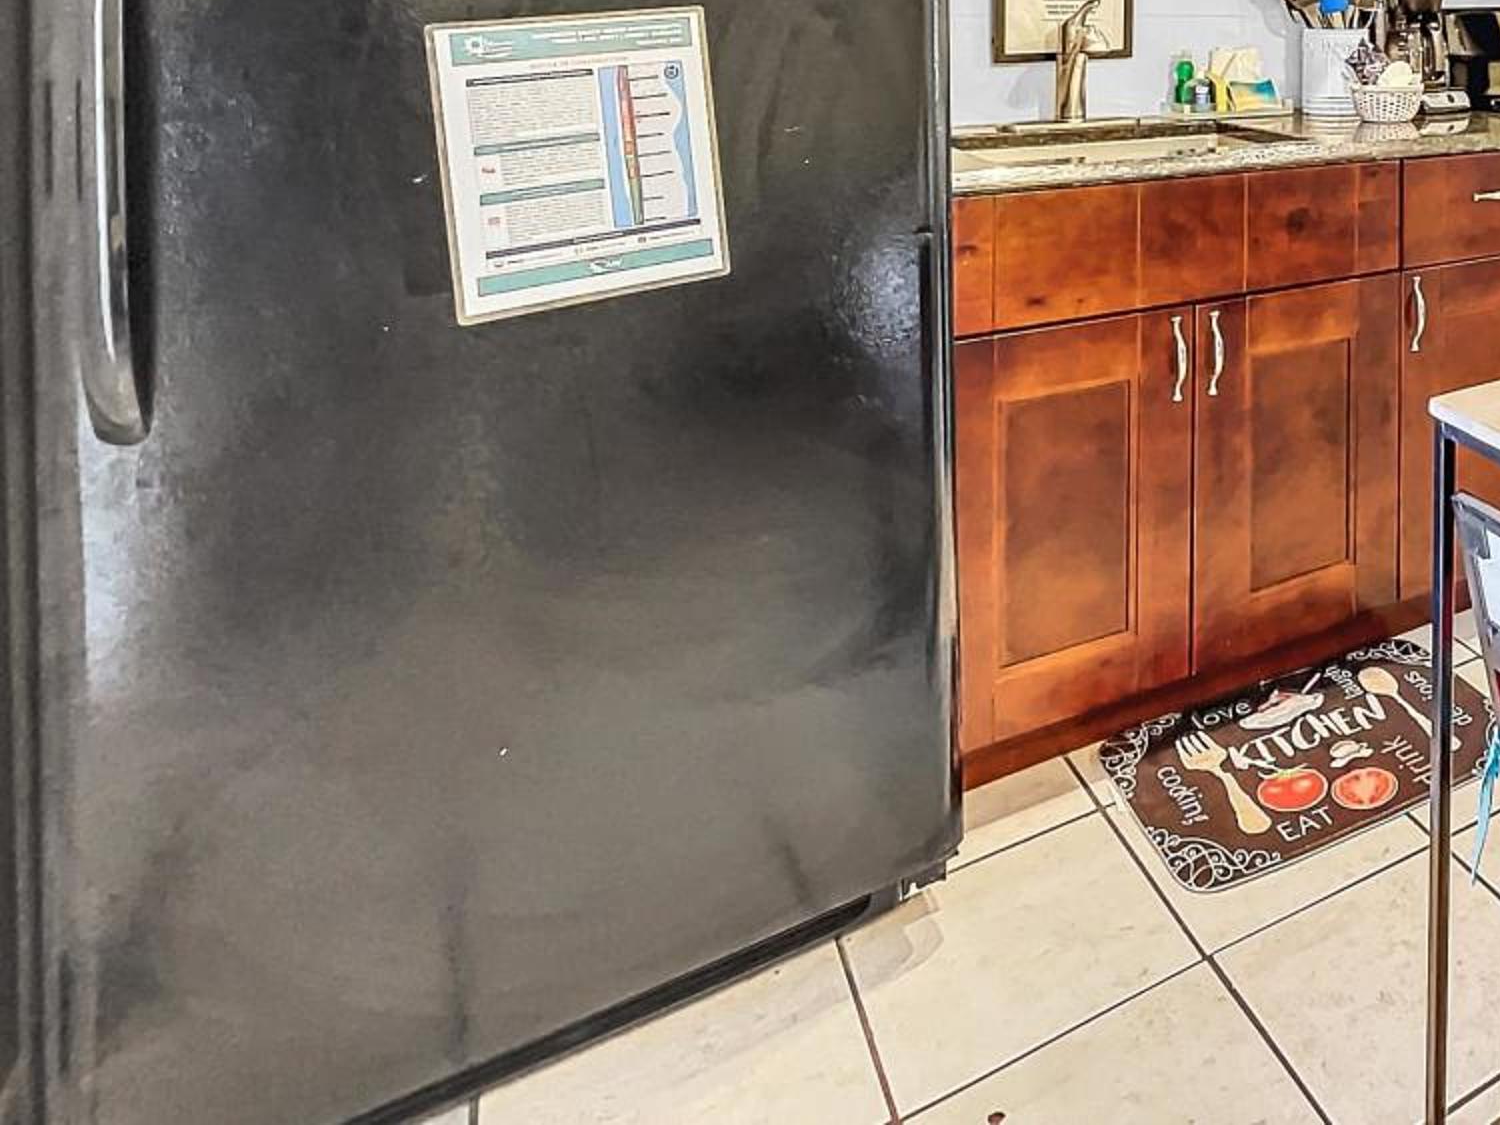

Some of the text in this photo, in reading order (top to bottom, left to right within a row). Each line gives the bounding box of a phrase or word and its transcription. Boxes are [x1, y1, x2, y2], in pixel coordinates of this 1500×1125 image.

[1191, 702, 1251, 729] love
[1228, 693, 1387, 770] KITCHEN
[1276, 806, 1333, 842] EAT
